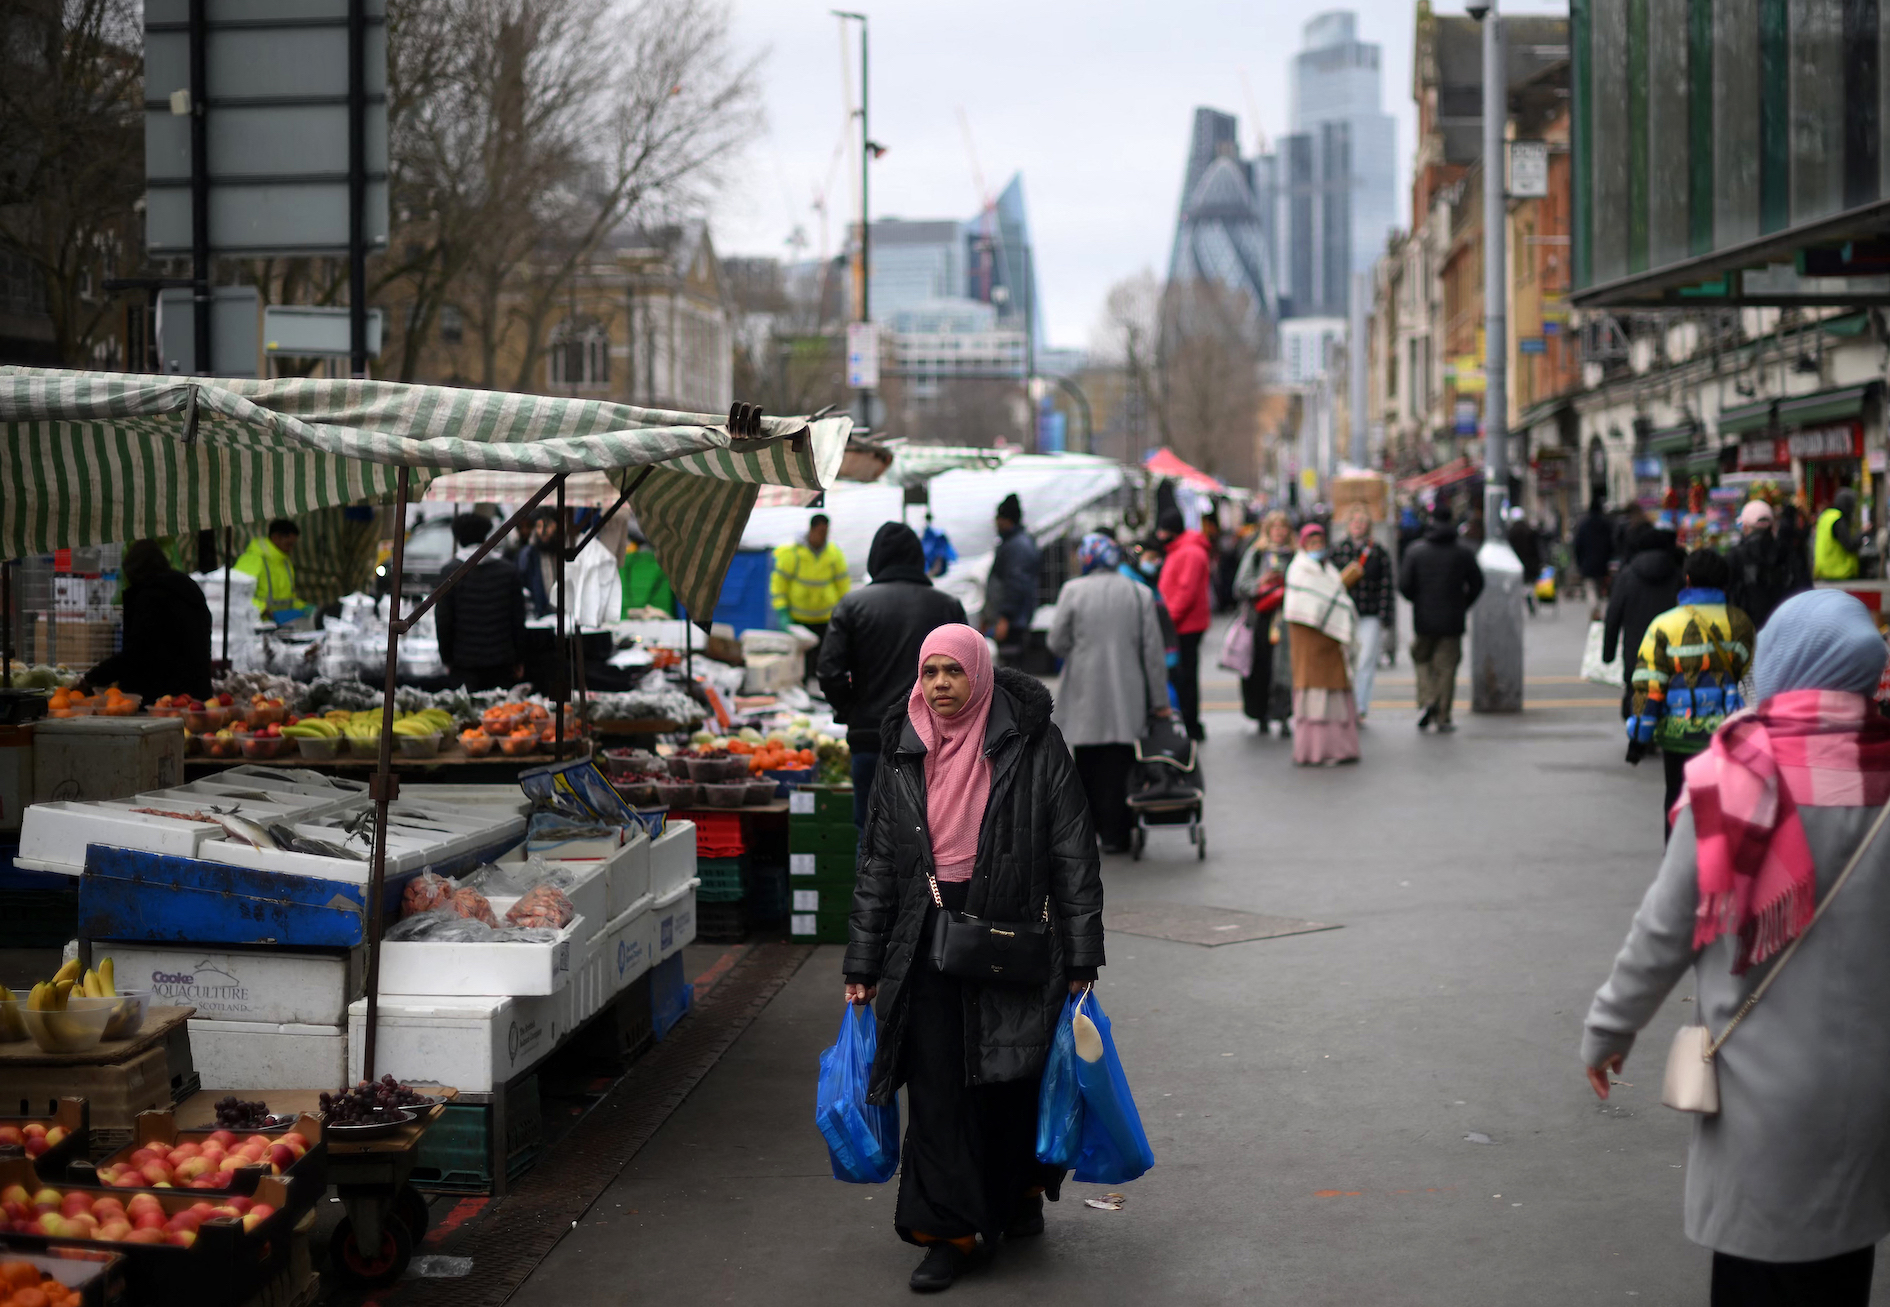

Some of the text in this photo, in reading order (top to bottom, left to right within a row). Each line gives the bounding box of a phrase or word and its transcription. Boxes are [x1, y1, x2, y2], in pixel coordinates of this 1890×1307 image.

[151, 971, 194, 985] Cooke
[151, 983, 249, 1001] AQUACULTURE
[198, 1001, 253, 1012] SCOTLAND
